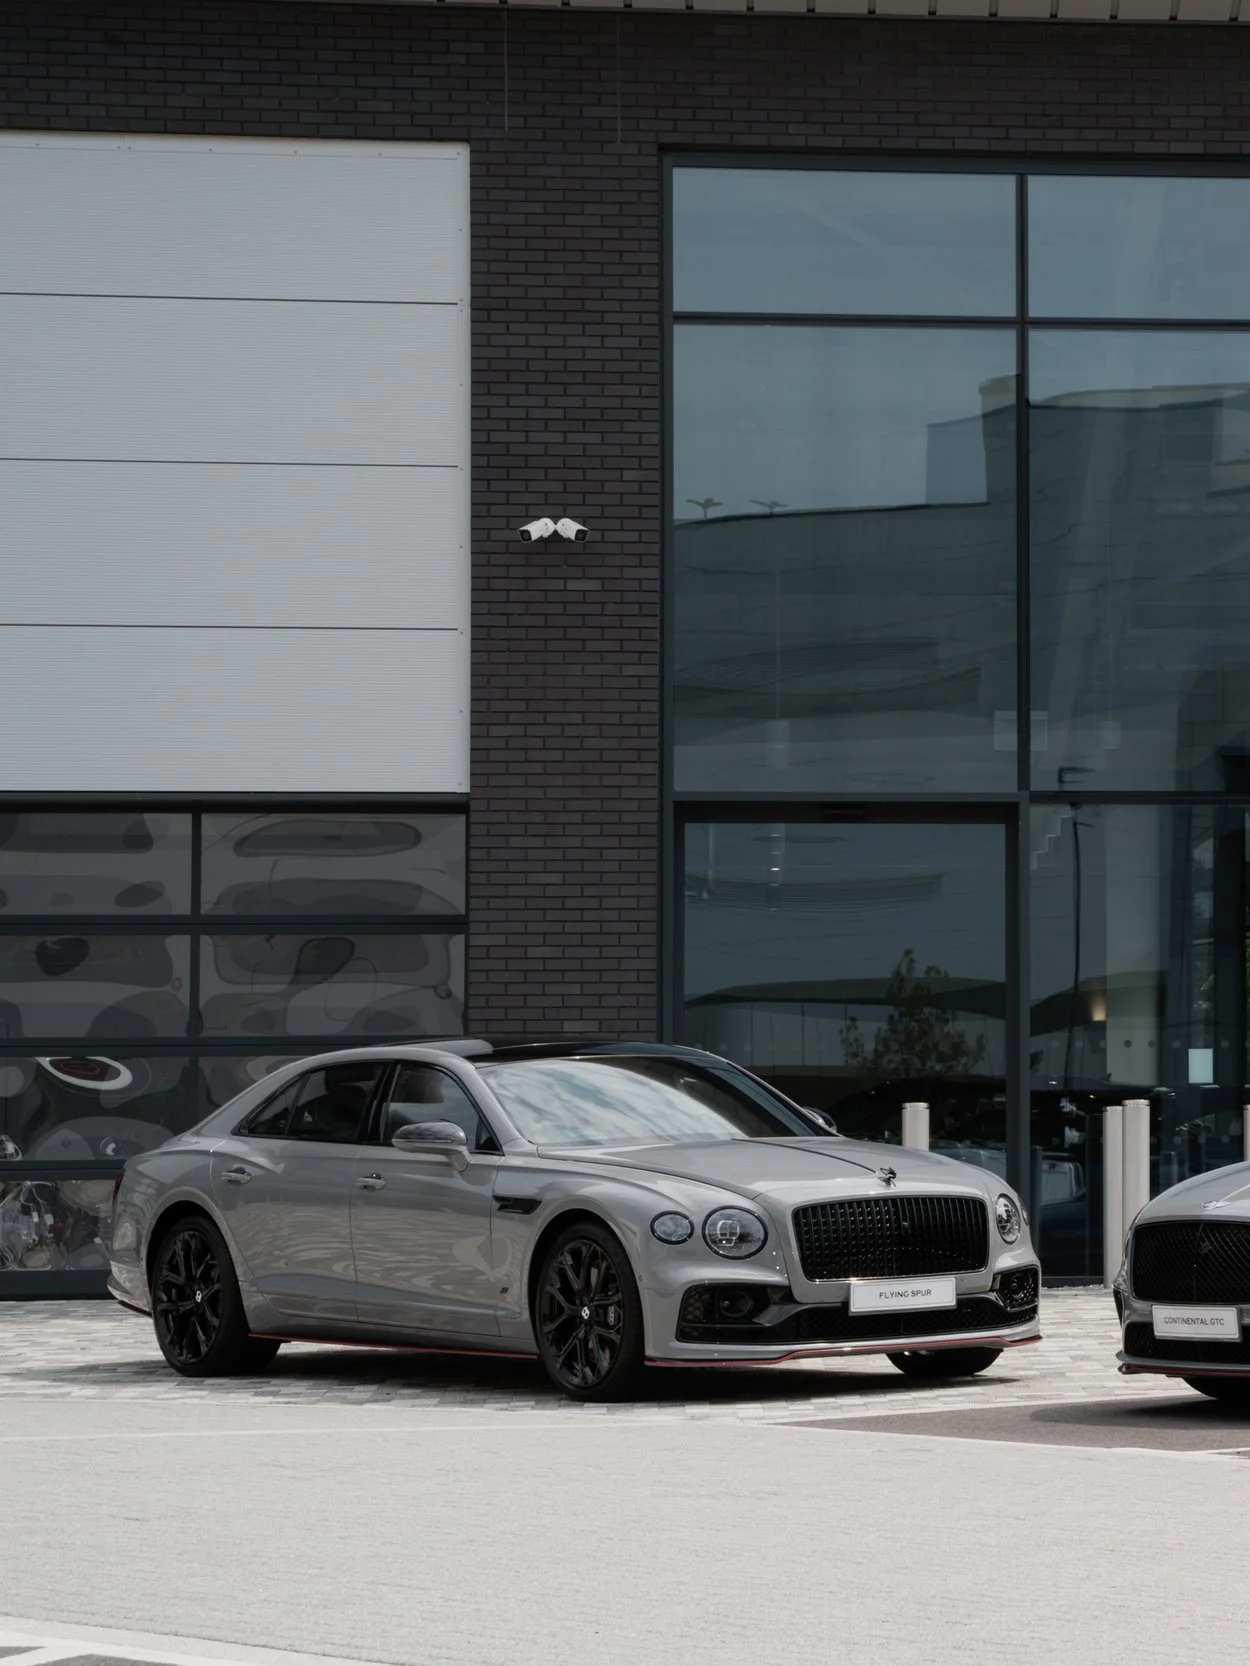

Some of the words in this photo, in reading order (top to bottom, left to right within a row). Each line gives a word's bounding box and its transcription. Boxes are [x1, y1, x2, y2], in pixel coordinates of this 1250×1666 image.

[879, 1290, 909, 1299] FLYING
[911, 1289, 932, 1297] SPUR
[1163, 1316, 1209, 1326] CONTINENTAL
[1210, 1318, 1225, 1326] GTC
